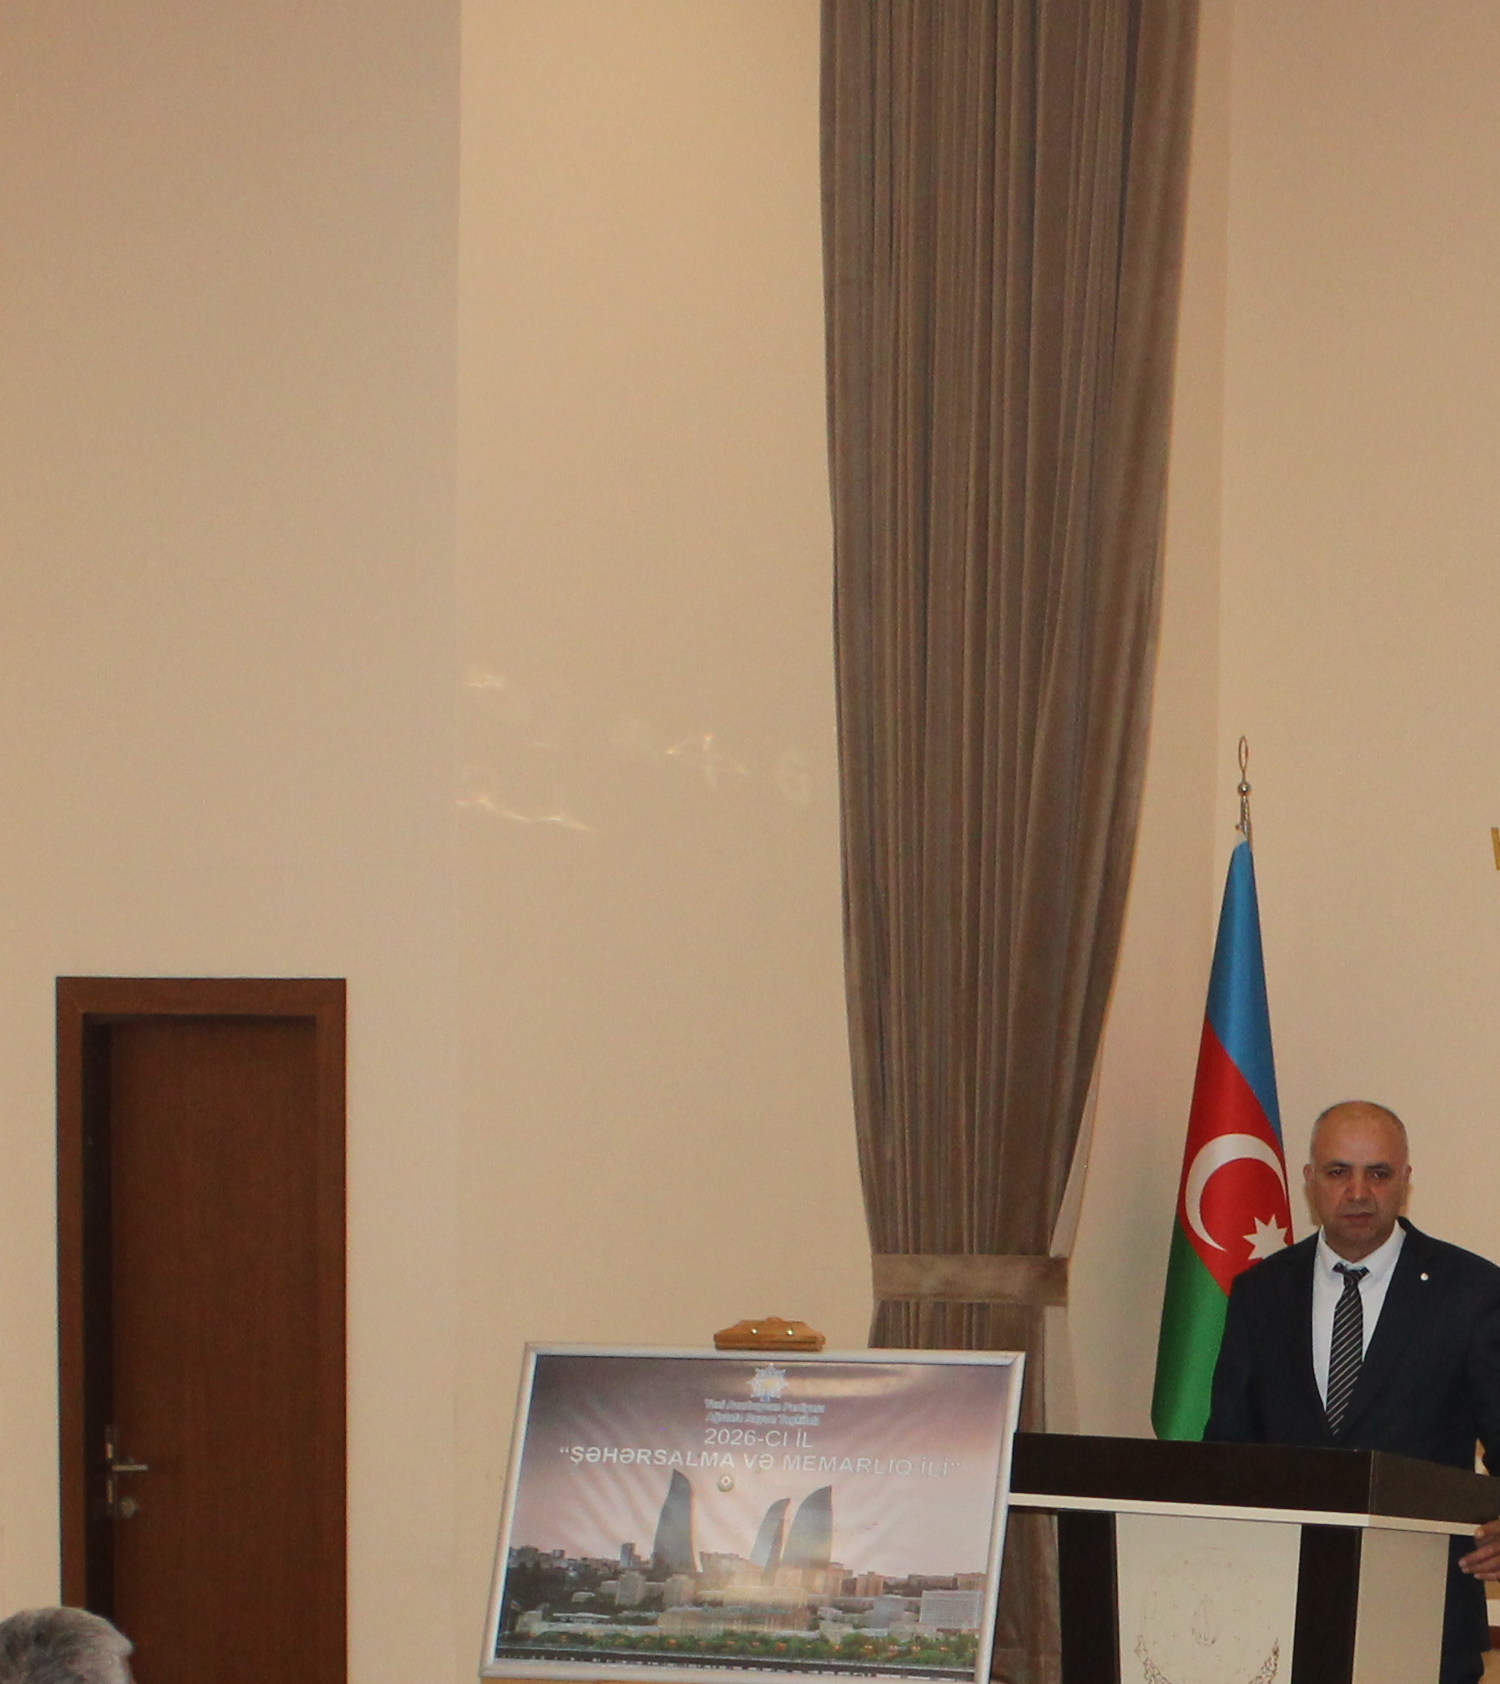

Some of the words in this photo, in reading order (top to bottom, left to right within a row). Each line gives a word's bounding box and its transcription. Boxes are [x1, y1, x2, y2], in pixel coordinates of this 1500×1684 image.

[703, 1428, 788, 1447] 2026-CI
[795, 1428, 813, 1449] İL
[743, 1452, 775, 1470] VƏ
[783, 1454, 913, 1476] MEMARLIQ
